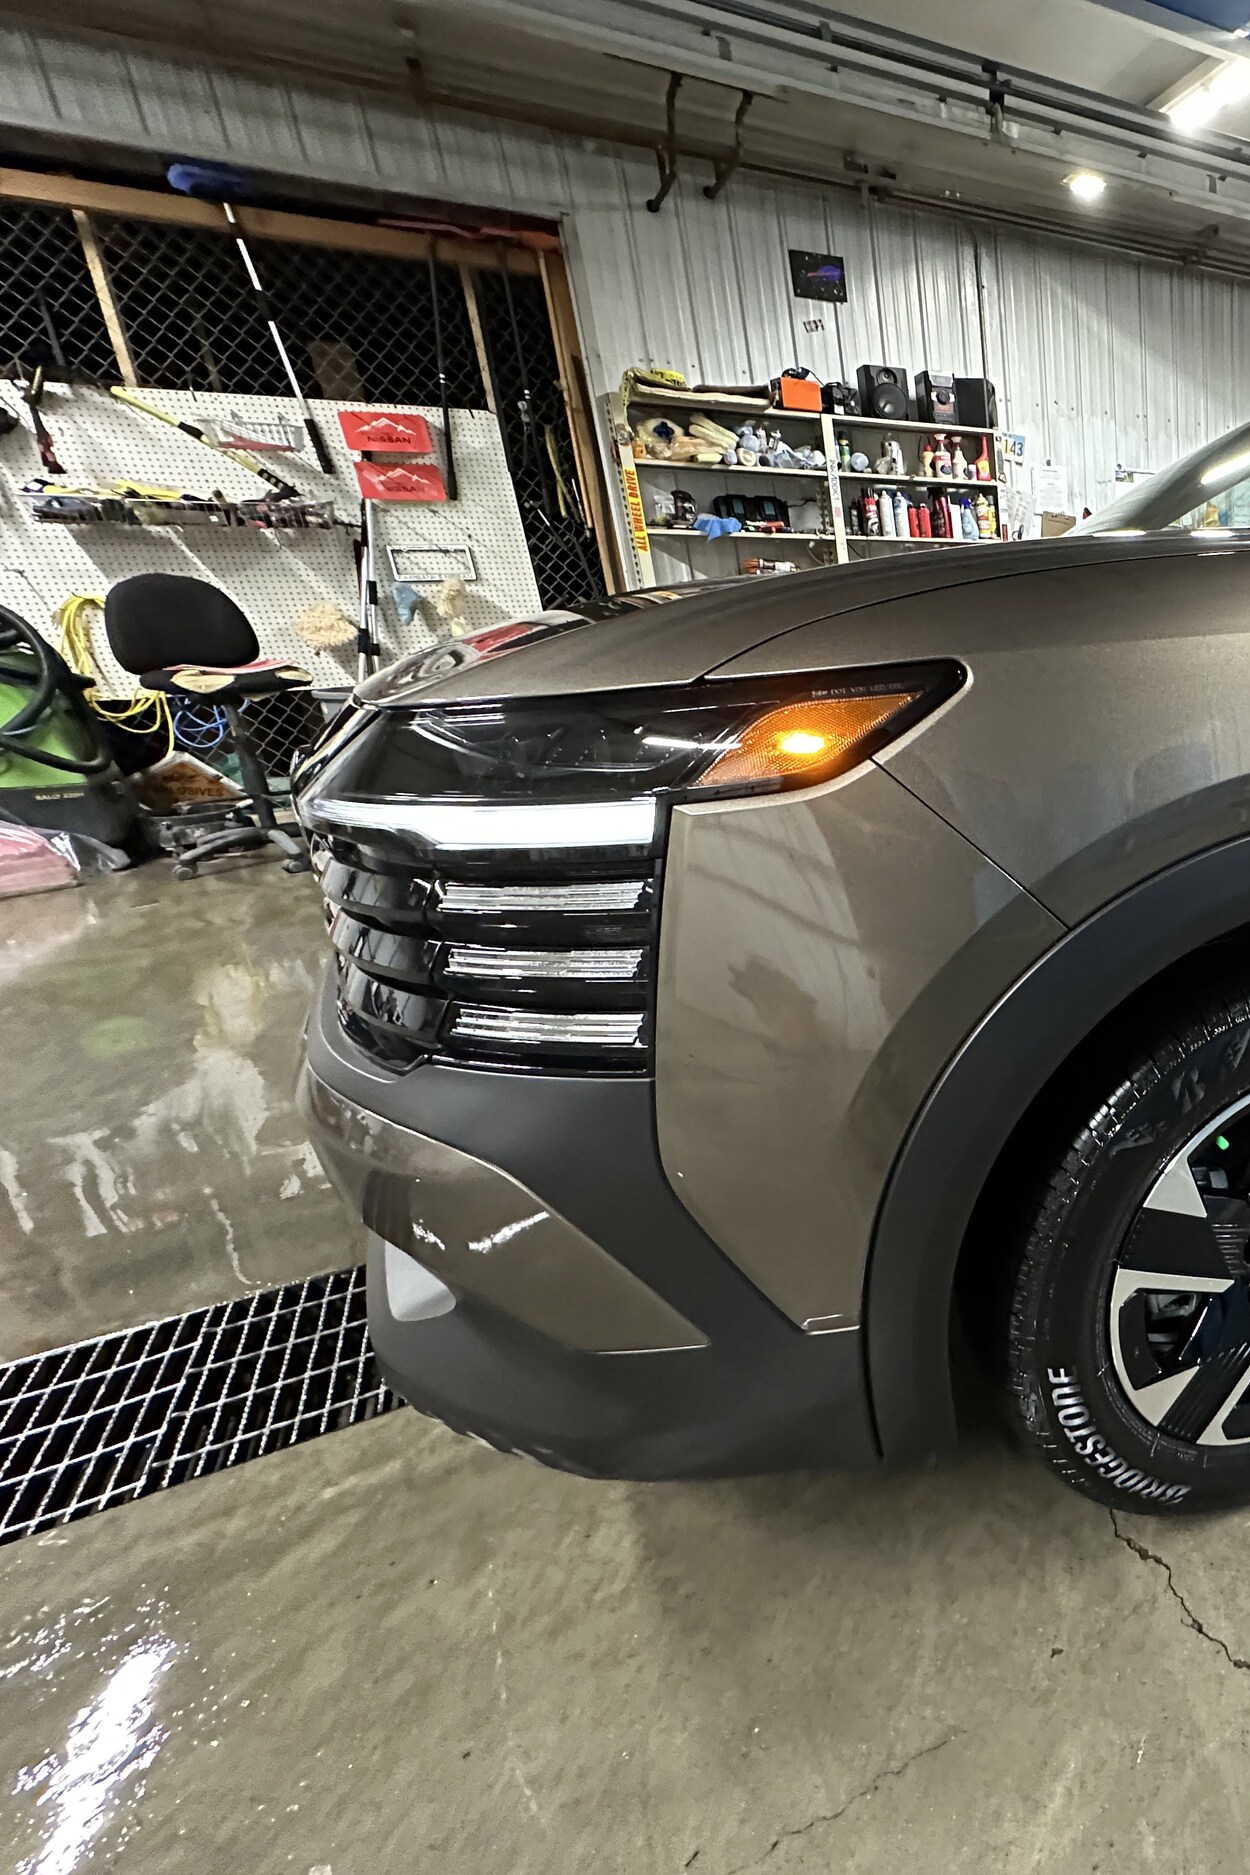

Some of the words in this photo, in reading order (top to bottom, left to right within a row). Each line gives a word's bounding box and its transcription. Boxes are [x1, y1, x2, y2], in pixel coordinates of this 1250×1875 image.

[367, 435, 412, 445] NISSAN
[624, 468, 640, 499] DRIVE
[629, 501, 646, 532] WHEEL
[635, 535, 649, 553] ALL
